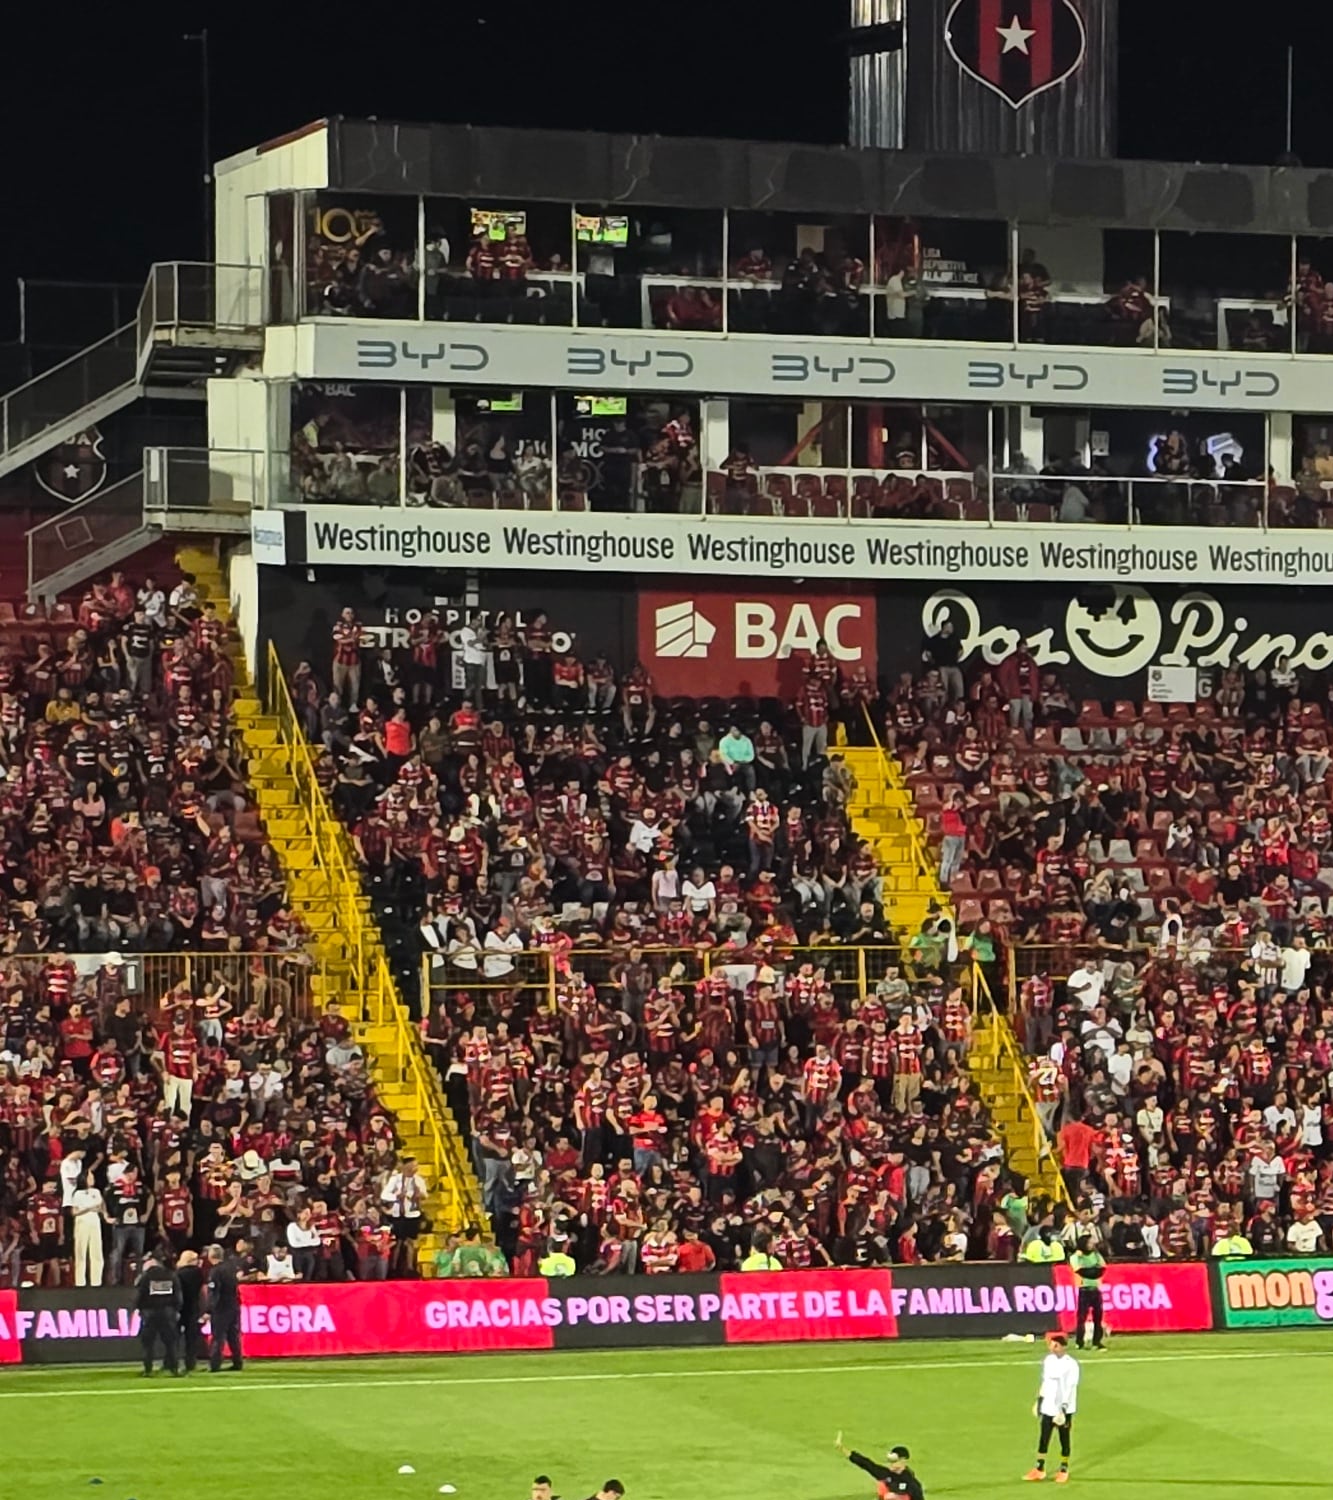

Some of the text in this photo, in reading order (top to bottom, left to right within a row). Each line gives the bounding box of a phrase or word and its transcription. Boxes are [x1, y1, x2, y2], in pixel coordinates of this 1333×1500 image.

[356, 340, 490, 370] BYD
[566, 347, 694, 378] BYD
[772, 355, 896, 385] BYD
[968, 361, 1089, 391] BYD
[1162, 368, 1281, 397] BYD
[314, 521, 492, 558] Westinghouse
[503, 526, 676, 564] Westinghouse
[688, 532, 856, 569] Westinghouse
[867, 537, 1030, 573] Westinghouse
[1041, 541, 1198, 576] Westinghouse
[734, 602, 862, 661] BAC
[425, 1282, 1173, 1329] GRACIAS POR SER PARTE DE LA FAMILIA ROJIEGRA
